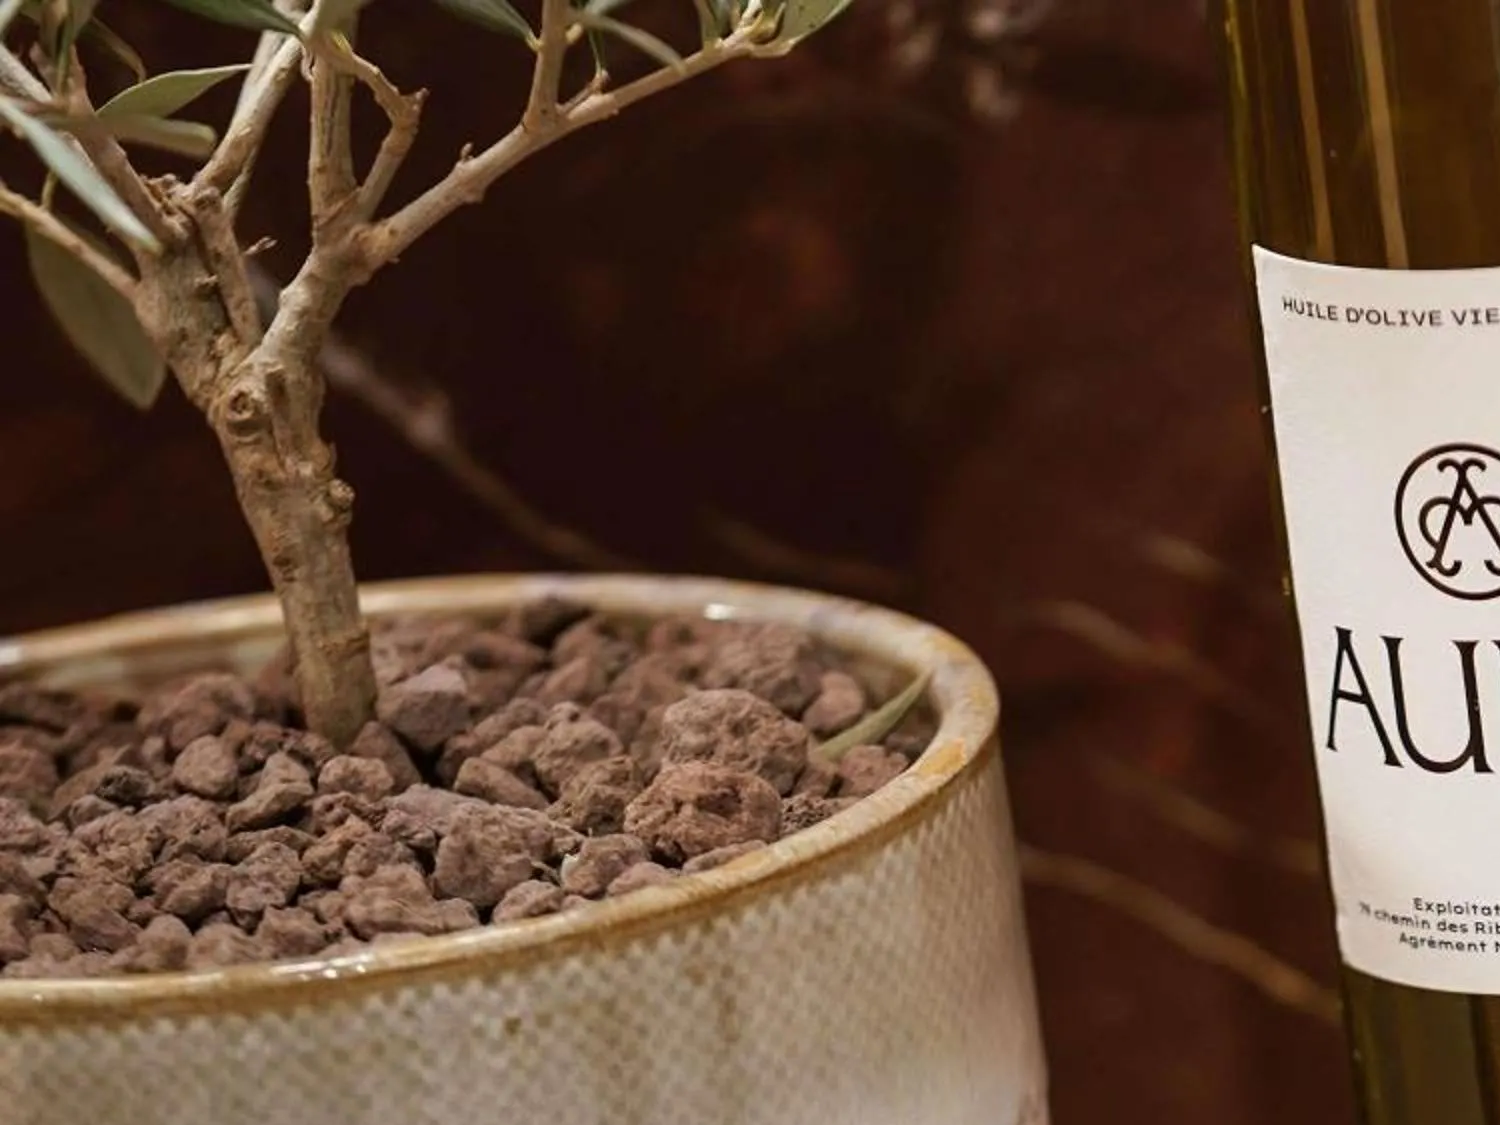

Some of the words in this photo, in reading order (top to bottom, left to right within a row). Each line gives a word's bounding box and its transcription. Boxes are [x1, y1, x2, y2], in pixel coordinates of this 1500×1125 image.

[1282, 296, 1338, 321] HUILE
[1345, 306, 1443, 327] D'OLIVE
[1373, 908, 1431, 930] chemin
[1437, 919, 1468, 933] des
[1400, 932, 1486, 953] Agrément
